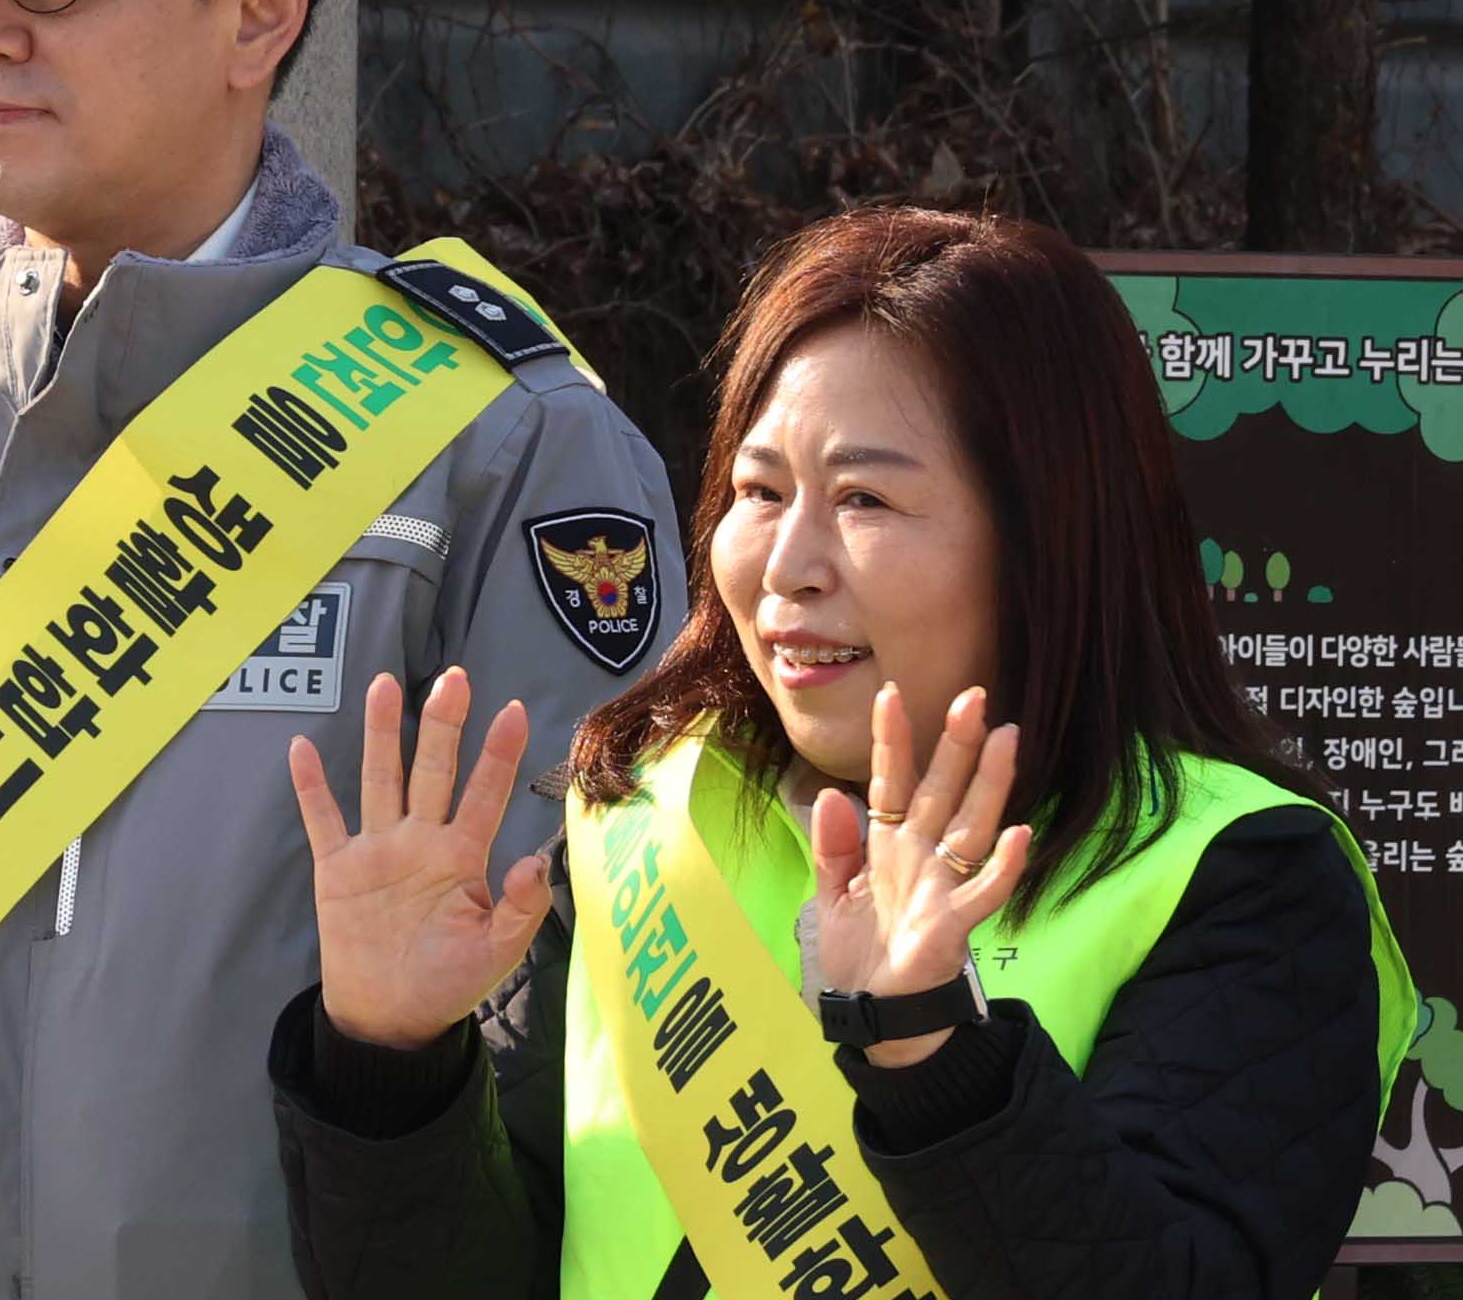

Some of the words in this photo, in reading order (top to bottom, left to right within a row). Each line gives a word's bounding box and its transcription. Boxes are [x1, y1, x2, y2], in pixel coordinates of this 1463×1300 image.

[1160, 334, 1231, 378] 함께
[1242, 334, 1349, 380] 가꾸고
[1359, 338, 1463, 383] 누리는
[233, 301, 465, 491] 안전을
[282, 598, 328, 654] 찰
[588, 618, 639, 634] POLICE
[1321, 635, 1398, 667] 다양한
[1403, 635, 1463, 667] 사람
[216, 667, 324, 695] LICE
[1280, 685, 1384, 718] 디자인한
[1323, 736, 1413, 771] 장애인,
[1359, 790, 1441, 821] 누구도
[1362, 840, 1436, 872] 울리는
[603, 797, 738, 1094] 통안전을
